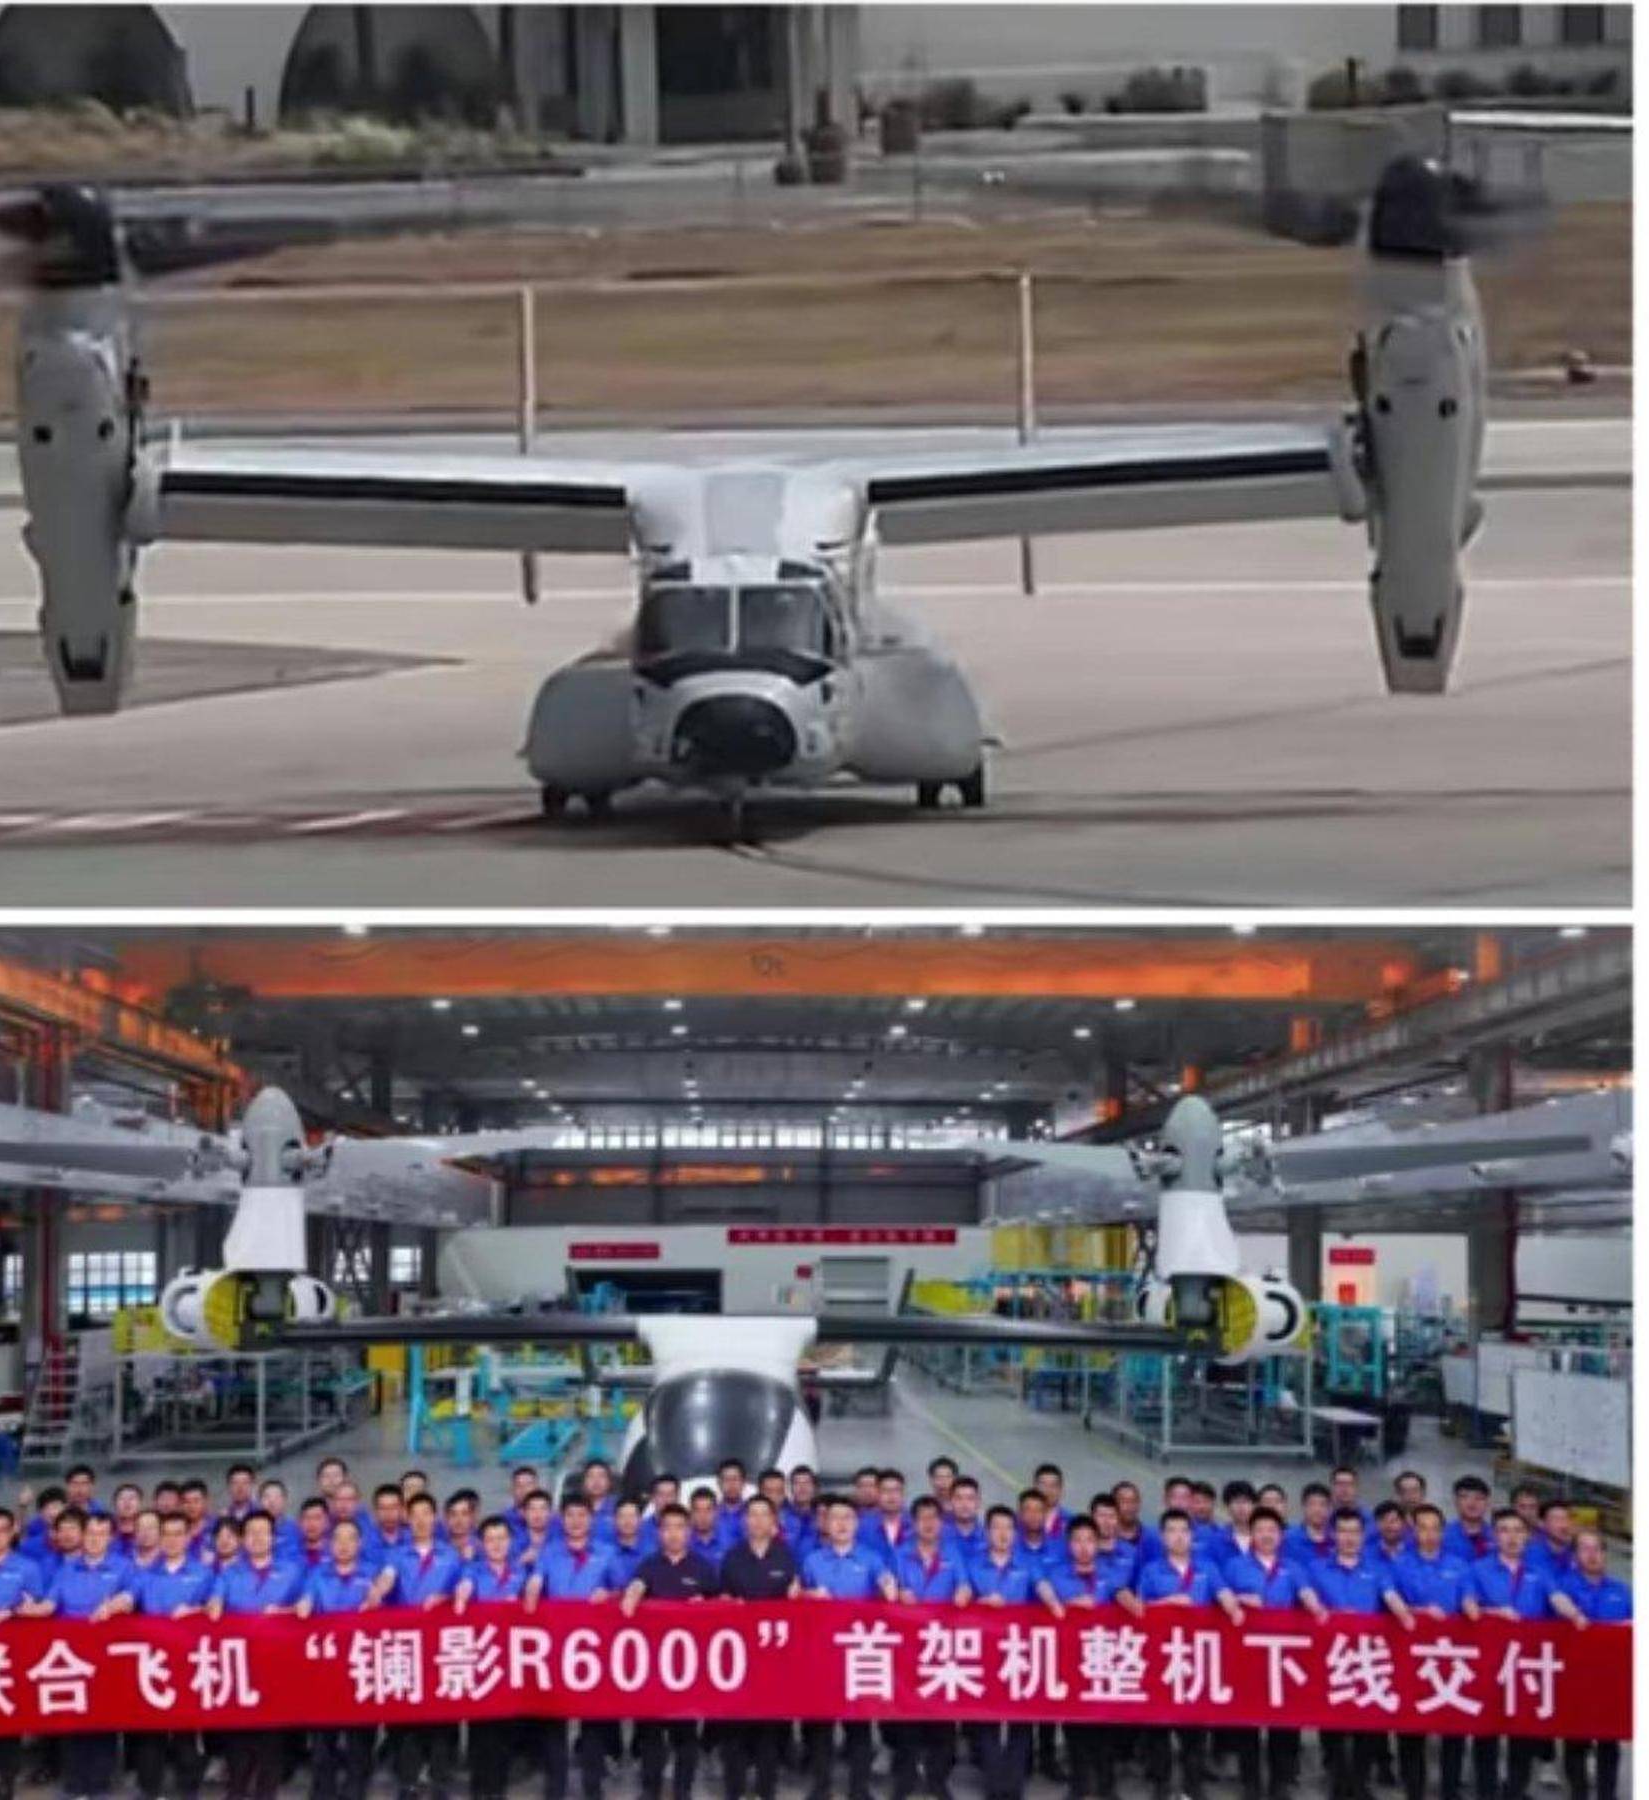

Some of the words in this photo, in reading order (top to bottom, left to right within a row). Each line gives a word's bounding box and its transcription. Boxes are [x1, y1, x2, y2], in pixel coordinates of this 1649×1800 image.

[833, 1620, 1565, 1719] 首架机整机下线交付
